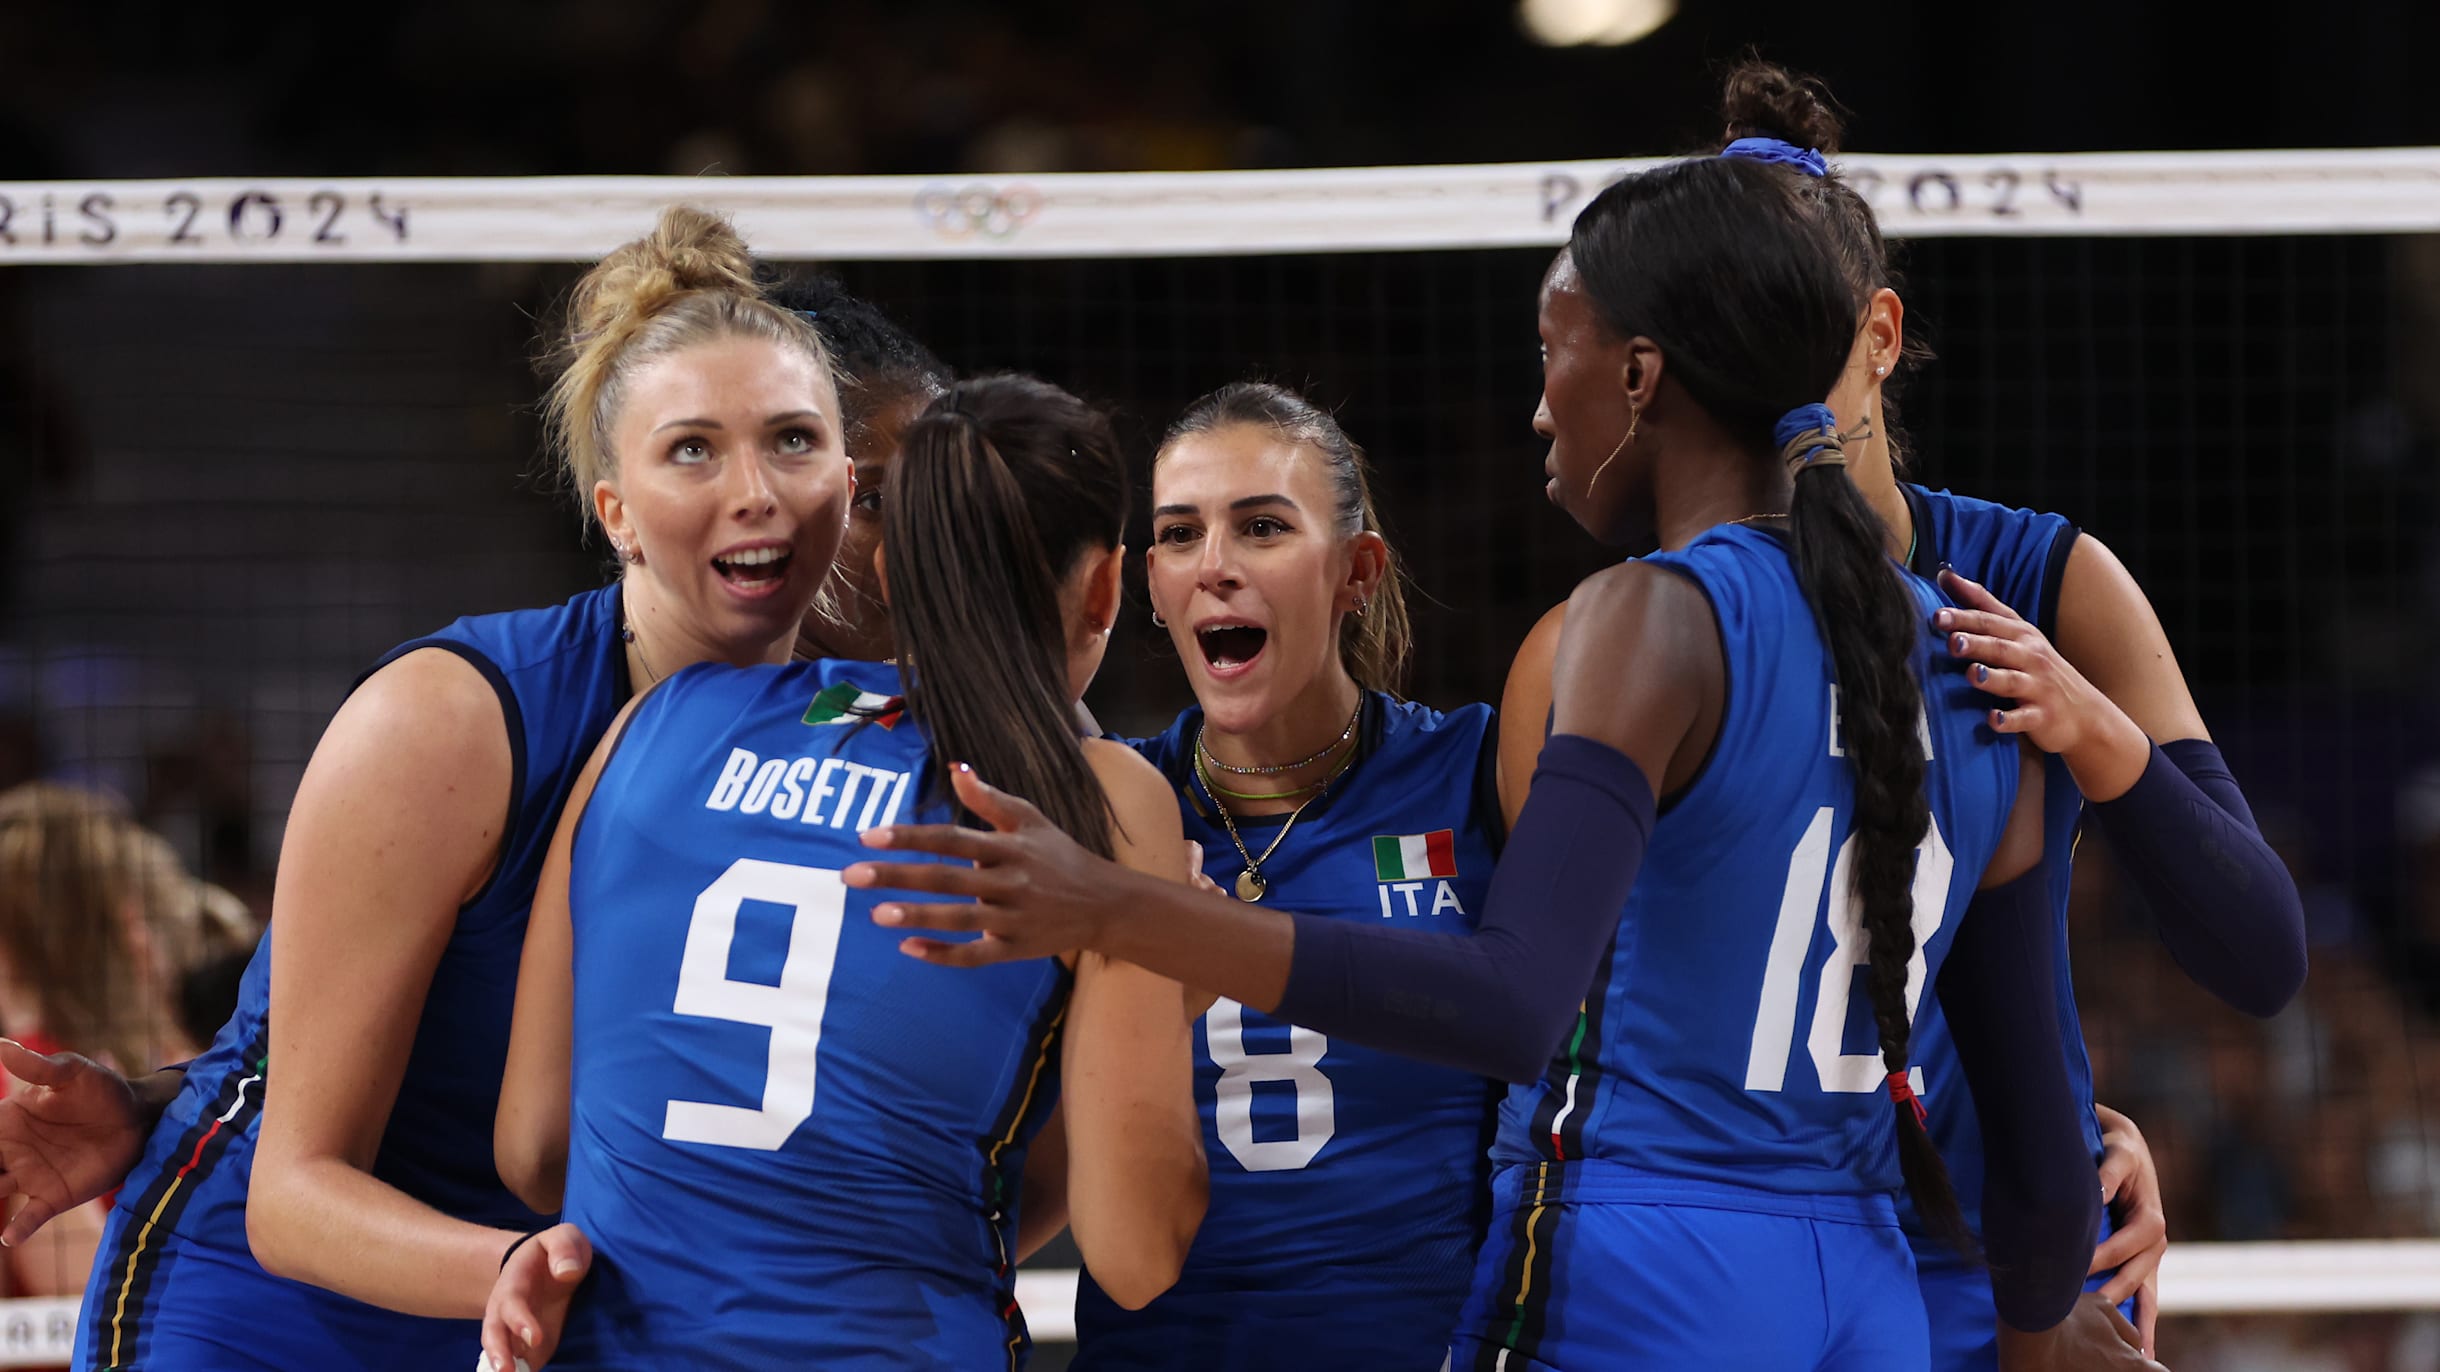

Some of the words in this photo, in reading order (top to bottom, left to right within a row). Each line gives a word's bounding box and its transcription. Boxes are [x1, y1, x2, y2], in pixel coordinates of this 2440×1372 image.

[164, 191, 410, 245] 2024
[706, 746, 911, 834] BOSETTI
[1377, 880, 1465, 918] ITA
[1744, 806, 1954, 1093] 18
[663, 857, 848, 1151] 9
[1206, 995, 1335, 1172] 8
